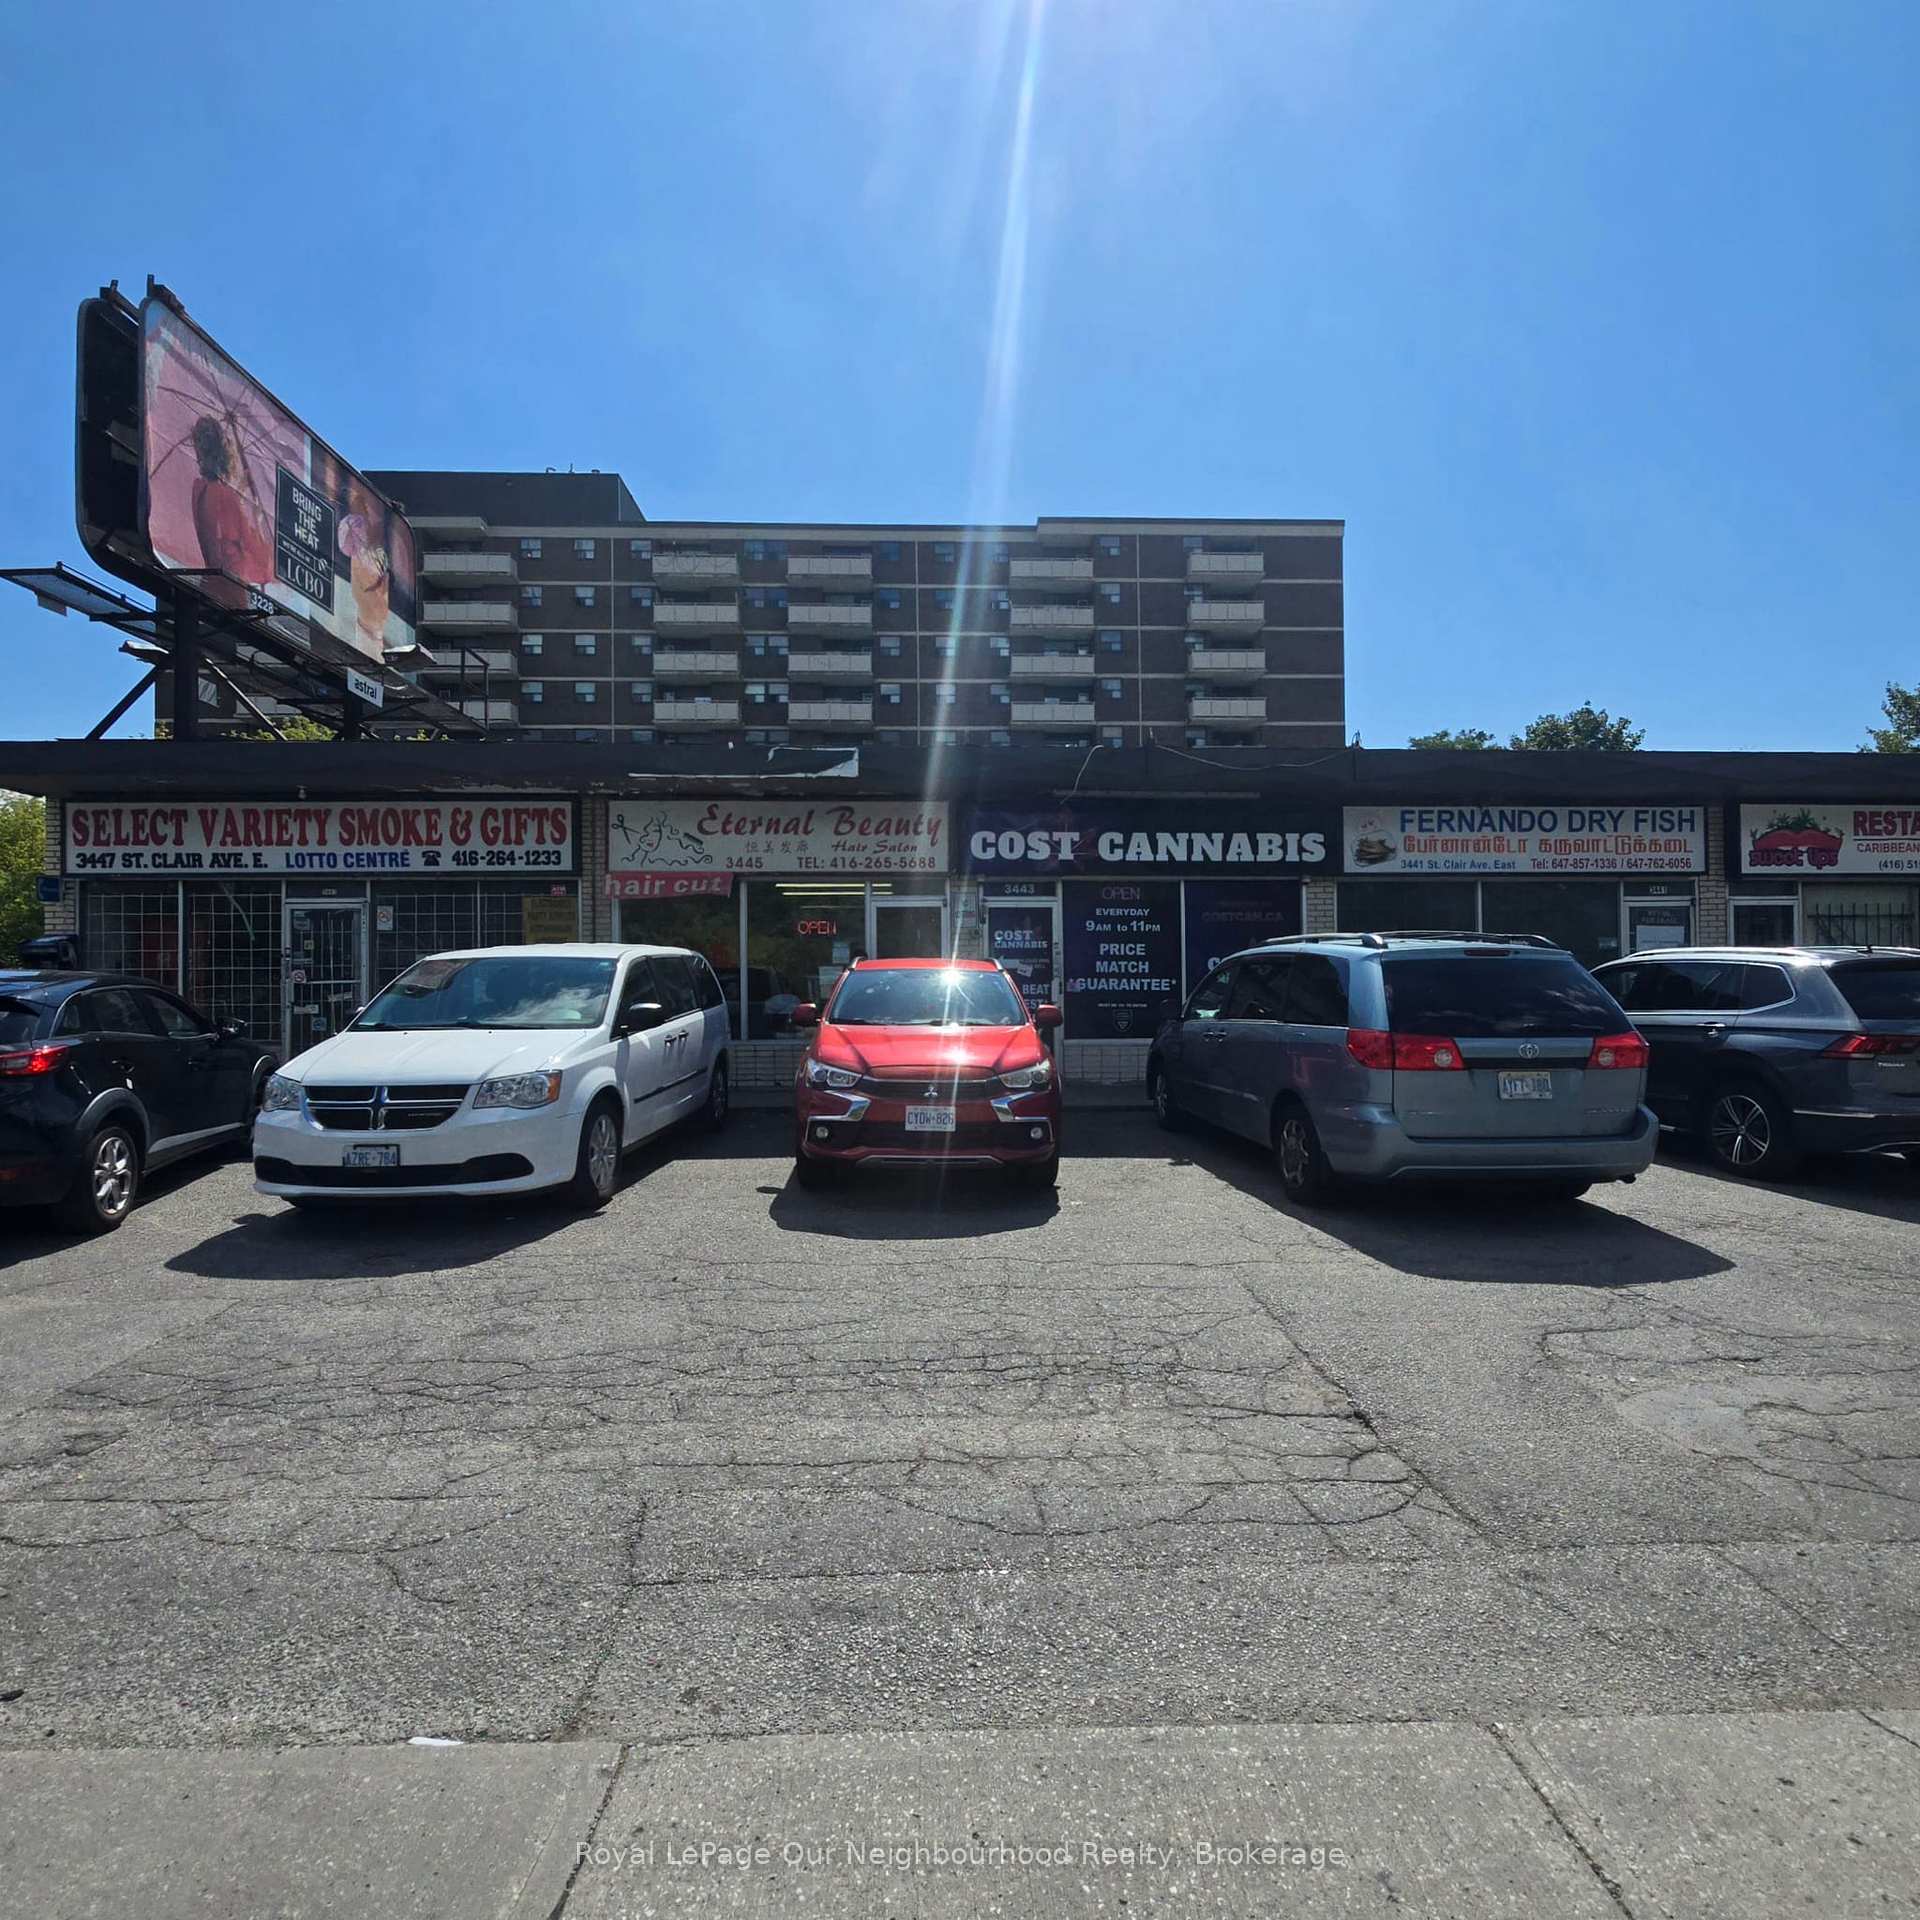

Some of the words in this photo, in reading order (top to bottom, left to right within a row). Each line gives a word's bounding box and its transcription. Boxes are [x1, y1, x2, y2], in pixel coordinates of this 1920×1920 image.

[292, 487, 322, 521] BRING
[298, 507, 317, 535] THE
[294, 522, 320, 551] HEAT
[287, 557, 324, 599] LCBO
[251, 592, 274, 615] 3228
[354, 679, 377, 700] astral
[72, 808, 188, 847] SELECT
[197, 808, 332, 847] VARIETY
[338, 807, 443, 847] SMOKE
[449, 807, 474, 847] &
[480, 807, 567, 847] GIFTS
[697, 803, 815, 836] Eternal
[826, 806, 943, 847] Beauty
[1400, 809, 1558, 833] FERNANDO
[1568, 809, 1625, 833] DRY
[1634, 809, 1696, 833] FISH
[831, 840, 868, 854] Hair
[872, 839, 919, 854] Salon
[970, 831, 1080, 861] COST
[1098, 832, 1326, 863] CANNABIS
[76, 852, 116, 869] 3447
[121, 852, 148, 869] ST.
[151, 852, 204, 869] CLAIR
[209, 852, 248, 869] AVE.
[252, 852, 268, 869] E.
[285, 852, 338, 869] LOTTO
[343, 851, 411, 869] CENTRE
[452, 850, 562, 867] 416-264-1233
[726, 856, 764, 869] 3445
[797, 856, 825, 869] TEL:
[830, 856, 936, 870] 416-265-5688
[1400, 859, 1424, 869] 3441
[1443, 859, 1467, 870] Clair
[1494, 859, 1516, 869] East
[1530, 858, 1549, 870] Tel:
[1551, 858, 1618, 870] 647-857-1336
[1626, 858, 1692, 870] 647-762-6056
[1879, 860, 1905, 871] (416)
[1906, 860, 1920, 869] 51
[605, 874, 666, 896] hair
[673, 876, 722, 894] cut
[1004, 884, 1035, 895] 3443
[1102, 886, 1140, 900] OPEN
[1096, 908, 1150, 916] EVERYDAY
[798, 920, 837, 935] OPEN
[1086, 920, 1111, 932] 9AM
[1117, 922, 1128, 932] to
[1130, 920, 1161, 932] 11PM
[994, 930, 1032, 941] COST
[994, 941, 1048, 949] CANNABIS
[1100, 943, 1146, 956] PRICE
[1096, 961, 1150, 973] MATCH
[1022, 984, 1050, 995] BEAT
